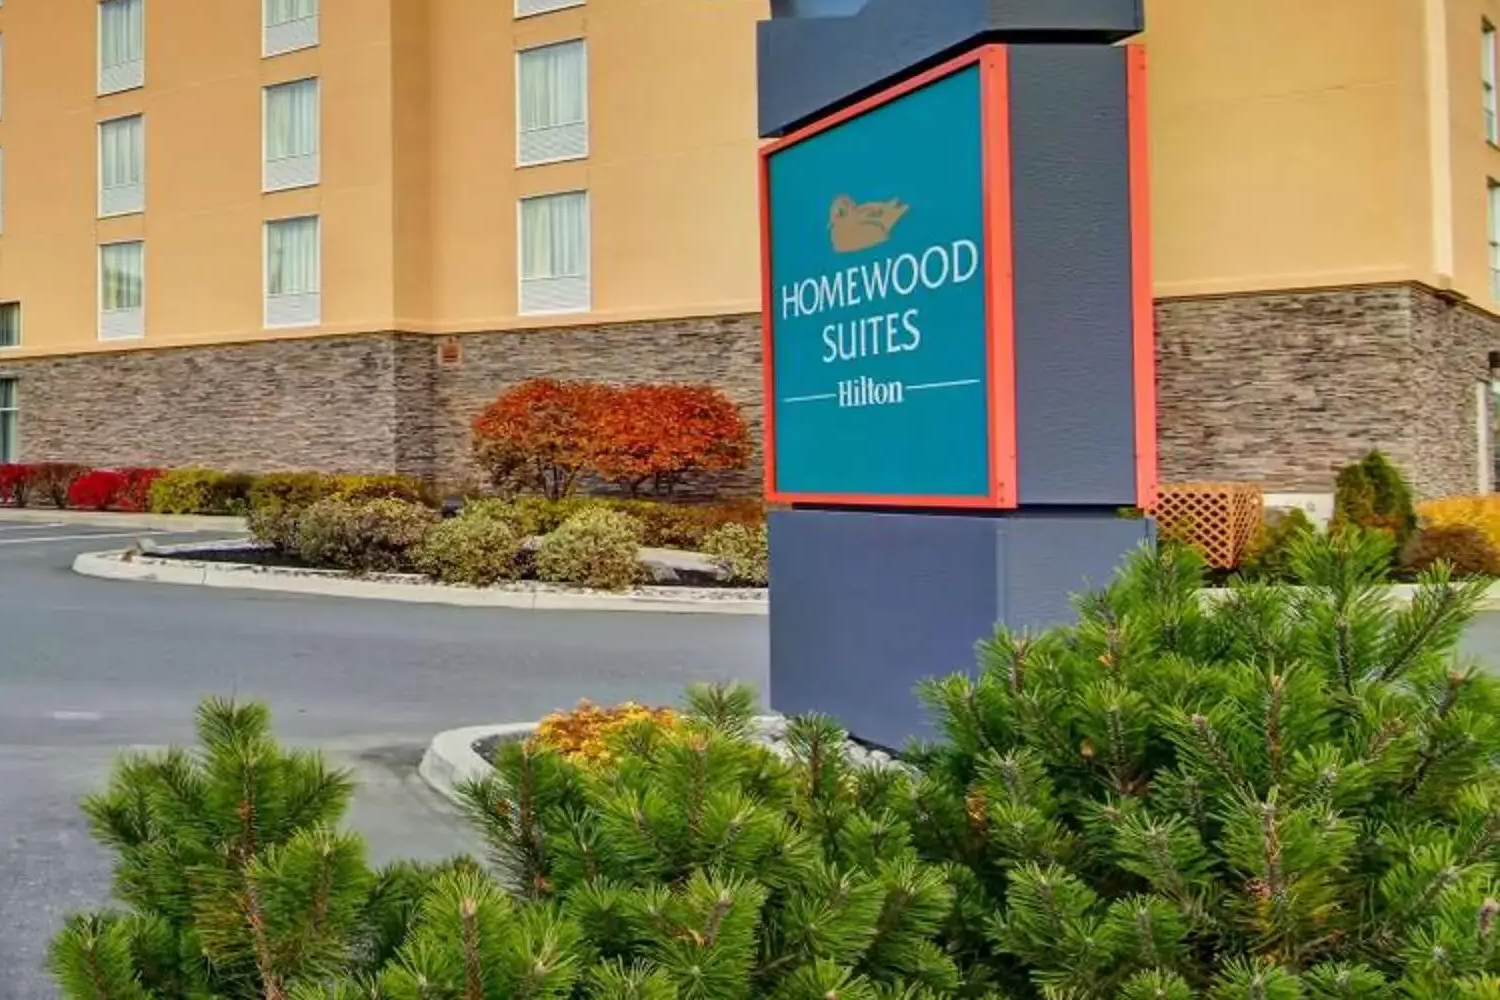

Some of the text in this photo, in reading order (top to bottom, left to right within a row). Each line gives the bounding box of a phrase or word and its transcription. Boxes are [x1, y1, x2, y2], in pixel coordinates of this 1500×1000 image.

[781, 239, 979, 320] HOMEWOOD
[822, 308, 921, 363] SUITES
[836, 376, 905, 408] Hilton
